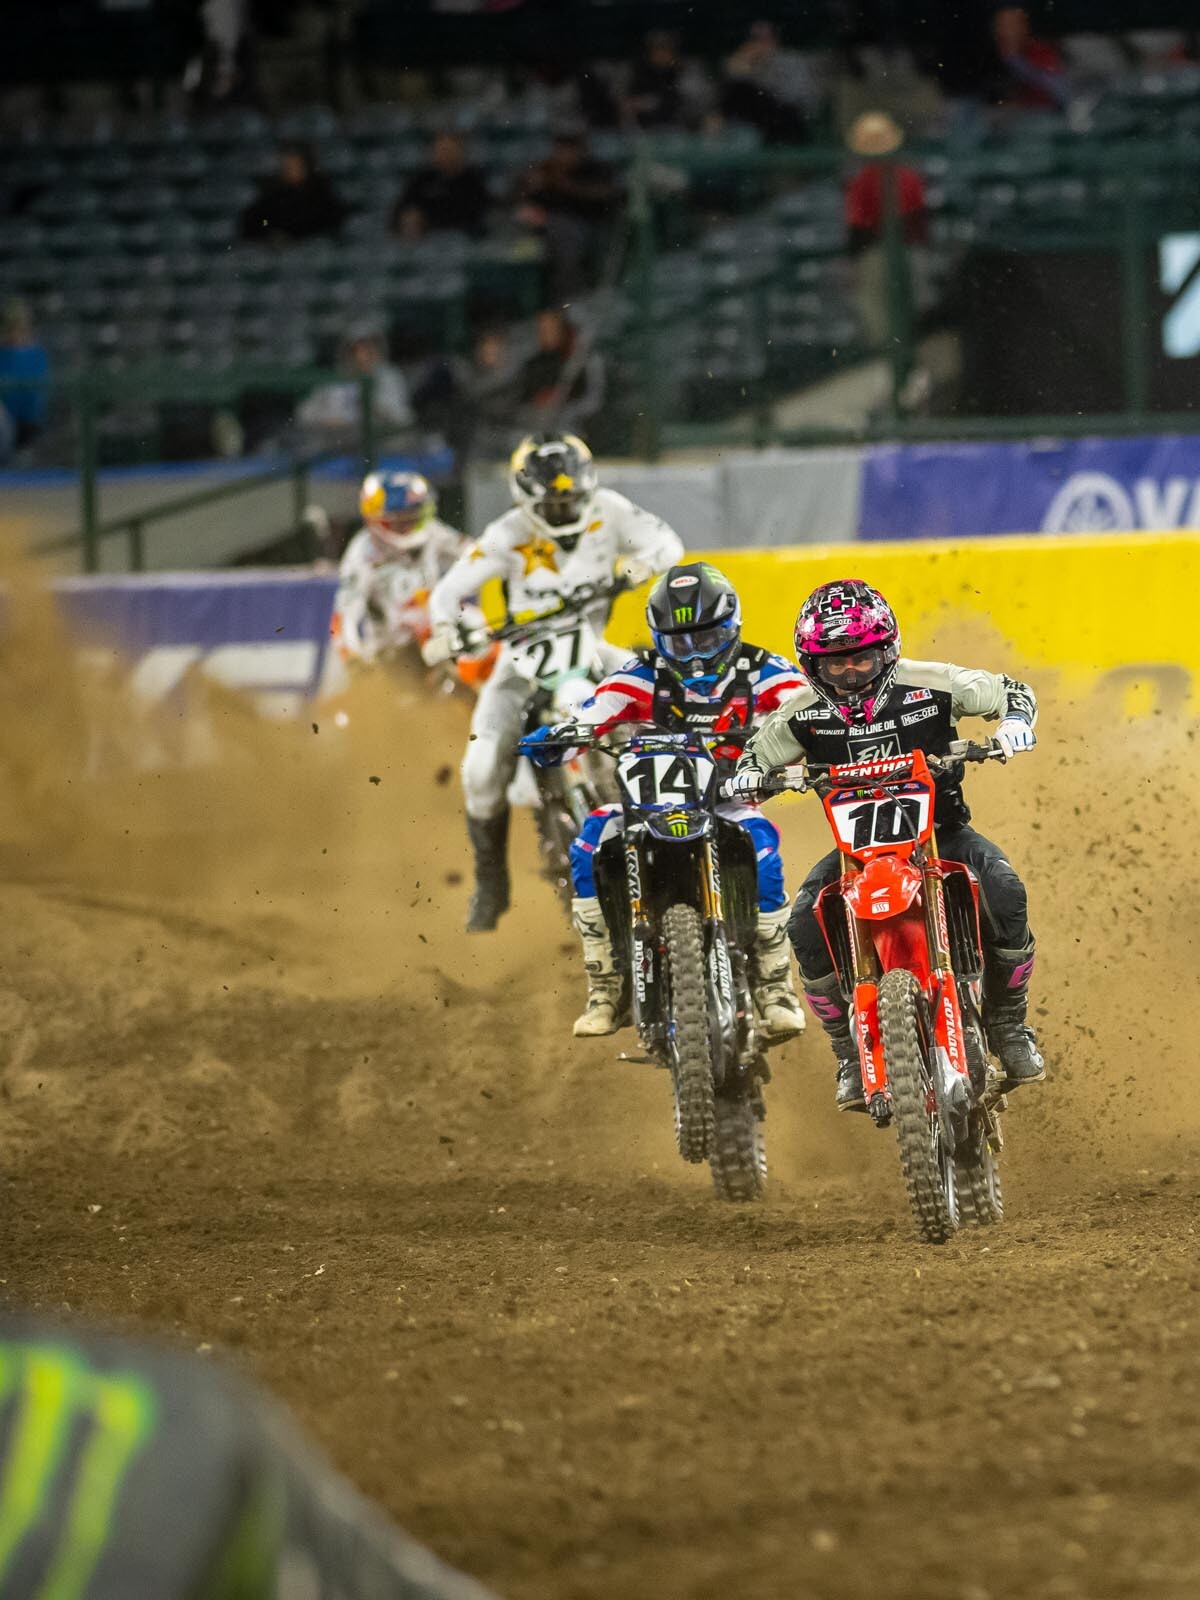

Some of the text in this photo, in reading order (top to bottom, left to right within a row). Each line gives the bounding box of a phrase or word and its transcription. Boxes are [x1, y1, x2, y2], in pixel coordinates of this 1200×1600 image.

[527, 629, 580, 679] 27
[795, 709, 832, 721] WPS
[903, 689, 932, 704] AMA
[866, 722, 884, 735] LINE
[884, 719, 898, 731] OIL
[626, 756, 701, 803] 14
[848, 798, 921, 851] 10
[715, 938, 731, 999] DUNLOP
[943, 997, 959, 1059] DUNLOP
